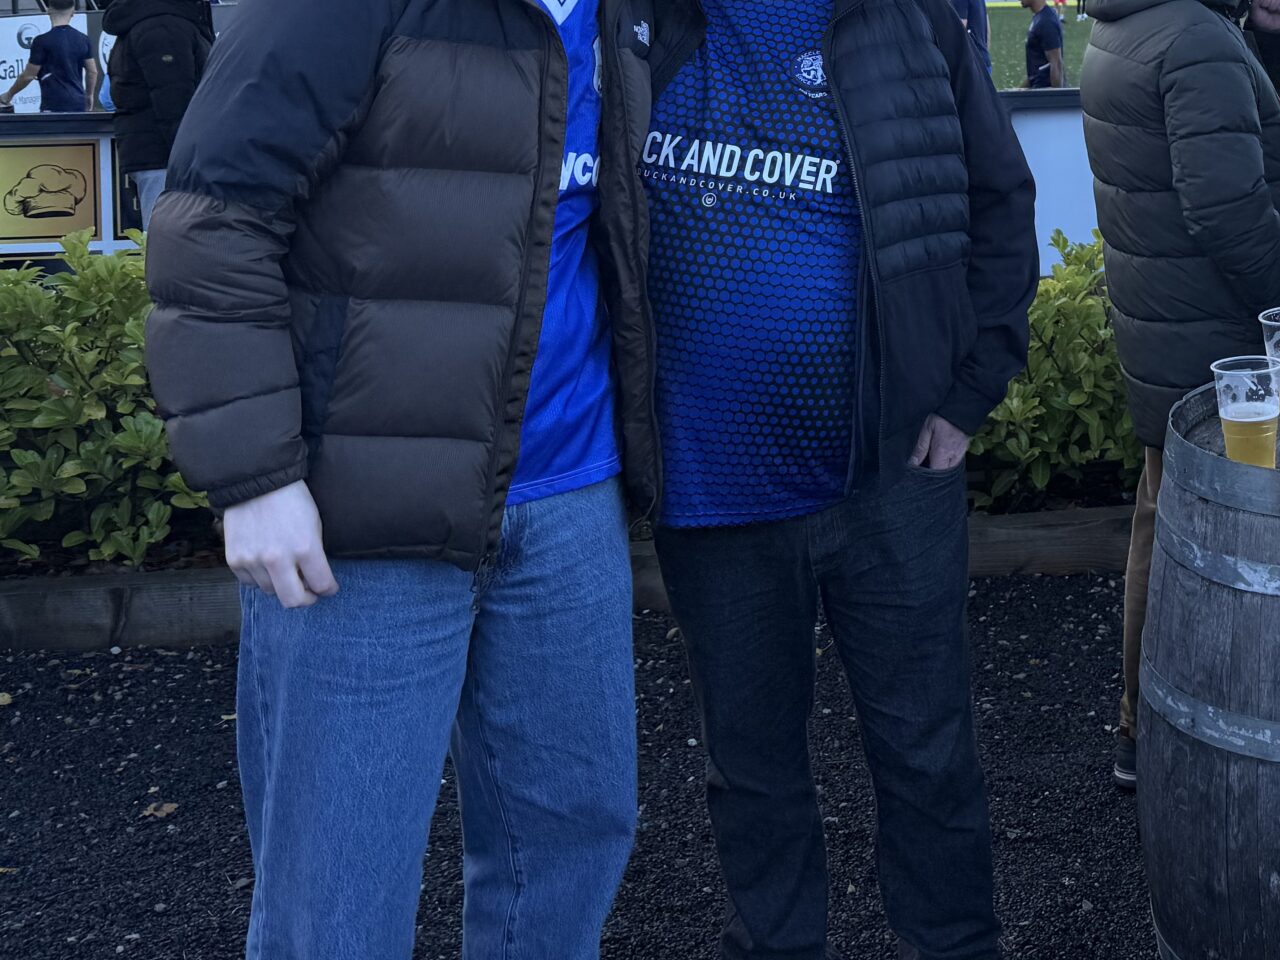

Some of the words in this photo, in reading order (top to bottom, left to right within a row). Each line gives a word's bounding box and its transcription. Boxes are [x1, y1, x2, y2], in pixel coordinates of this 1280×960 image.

[642, 131, 683, 169] CK
[680, 139, 742, 178] AND
[743, 148, 838, 194] COVER
